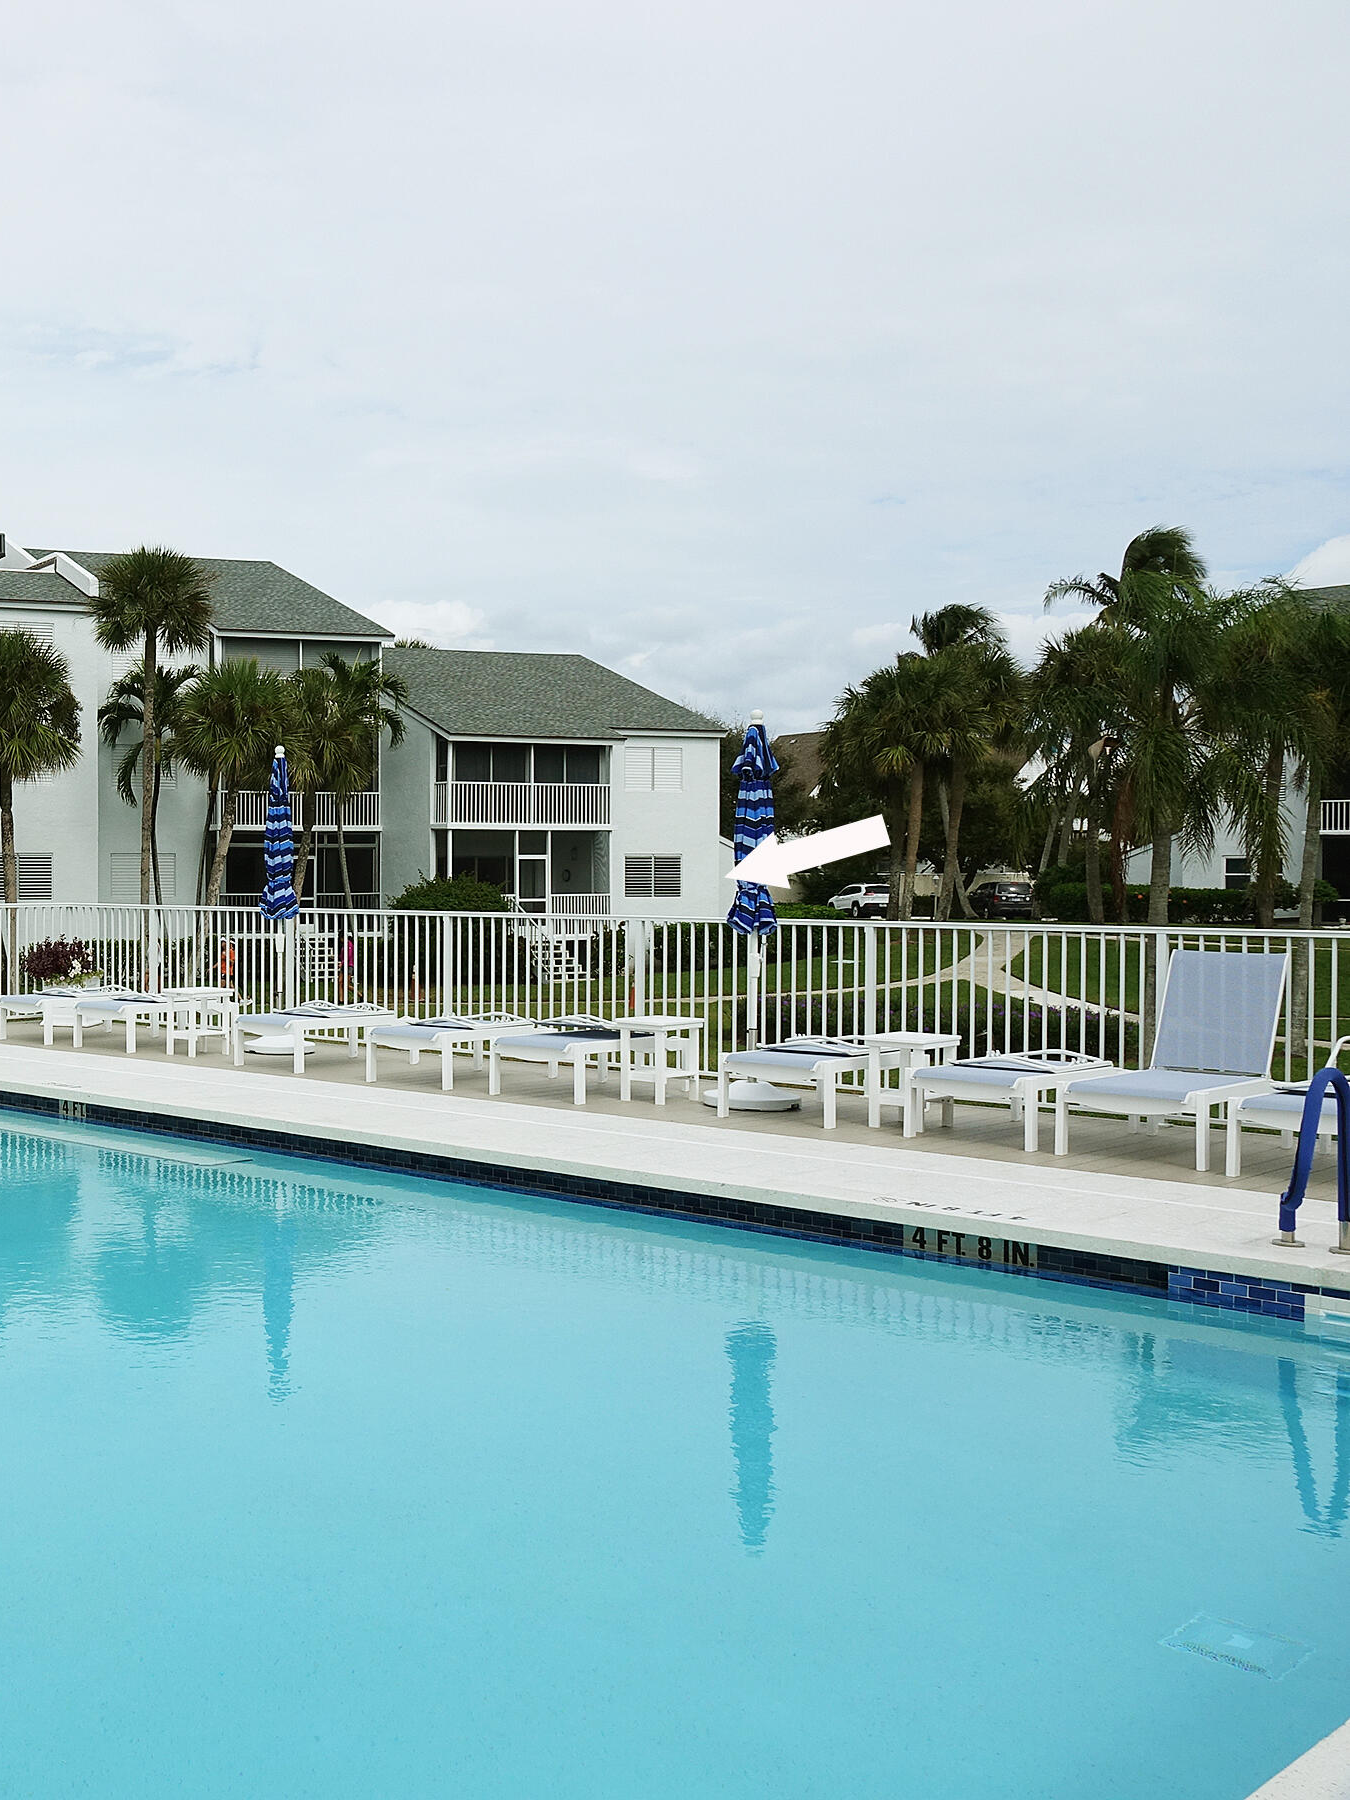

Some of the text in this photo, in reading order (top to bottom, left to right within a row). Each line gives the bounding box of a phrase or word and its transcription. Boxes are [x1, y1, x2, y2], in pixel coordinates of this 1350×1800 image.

[62, 1100, 69, 1115] 4
[912, 1227, 1035, 1268] 4 FT. 8 IN.
